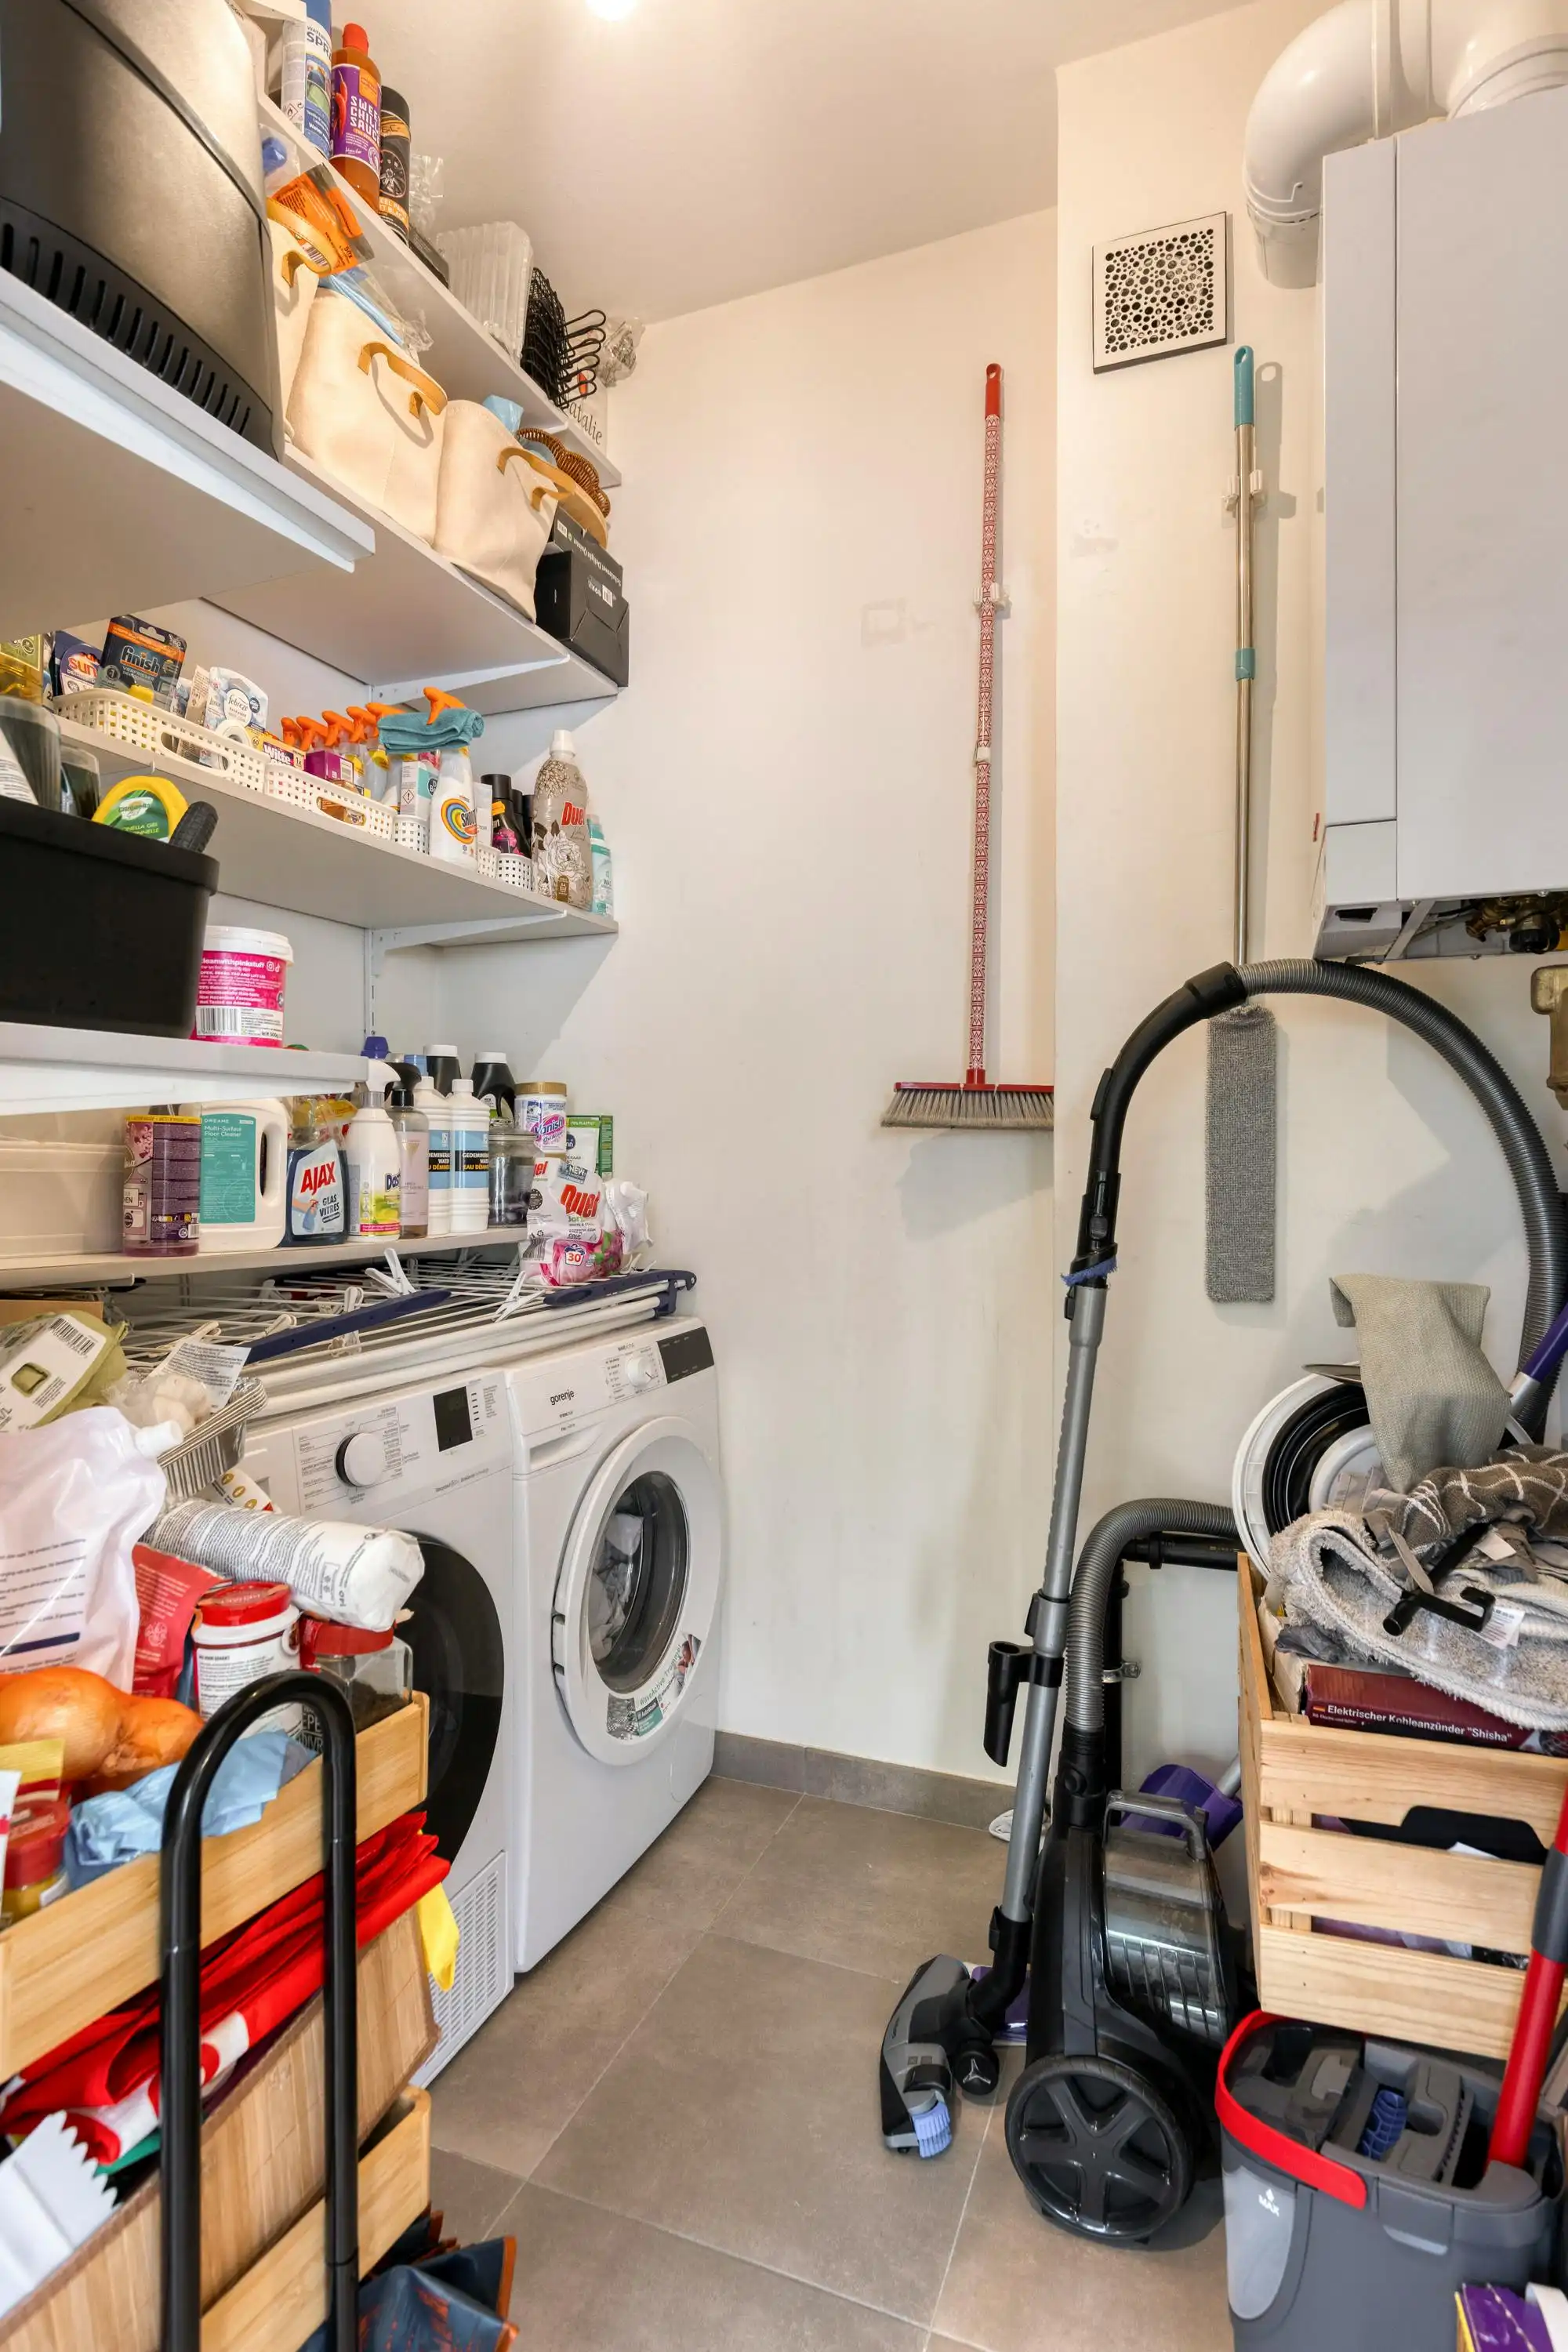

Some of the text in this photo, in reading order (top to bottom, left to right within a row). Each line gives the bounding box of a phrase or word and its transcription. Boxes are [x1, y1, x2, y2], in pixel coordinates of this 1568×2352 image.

[568, 401, 602, 445] atalie
[120, 645, 161, 675] finish
[228, 694, 249, 712] febreze
[263, 743, 291, 764] Witte
[561, 801, 586, 826] Due
[534, 1116, 564, 1137] Vanish
[300, 1160, 336, 1196] AJAX
[568, 1164, 586, 1178] NEW
[319, 1202, 339, 1217] VITRES
[322, 1194, 337, 1207] GLAS
[568, 1252, 582, 1262] 30
[550, 1388, 575, 1406] gorenje
[1327, 1704, 1387, 1722] Elektrischer
[1388, 1715, 1465, 1736] Kohleanzünder
[1467, 1726, 1513, 1743] "Shisha"
[1258, 2194, 1279, 2217] MAX
